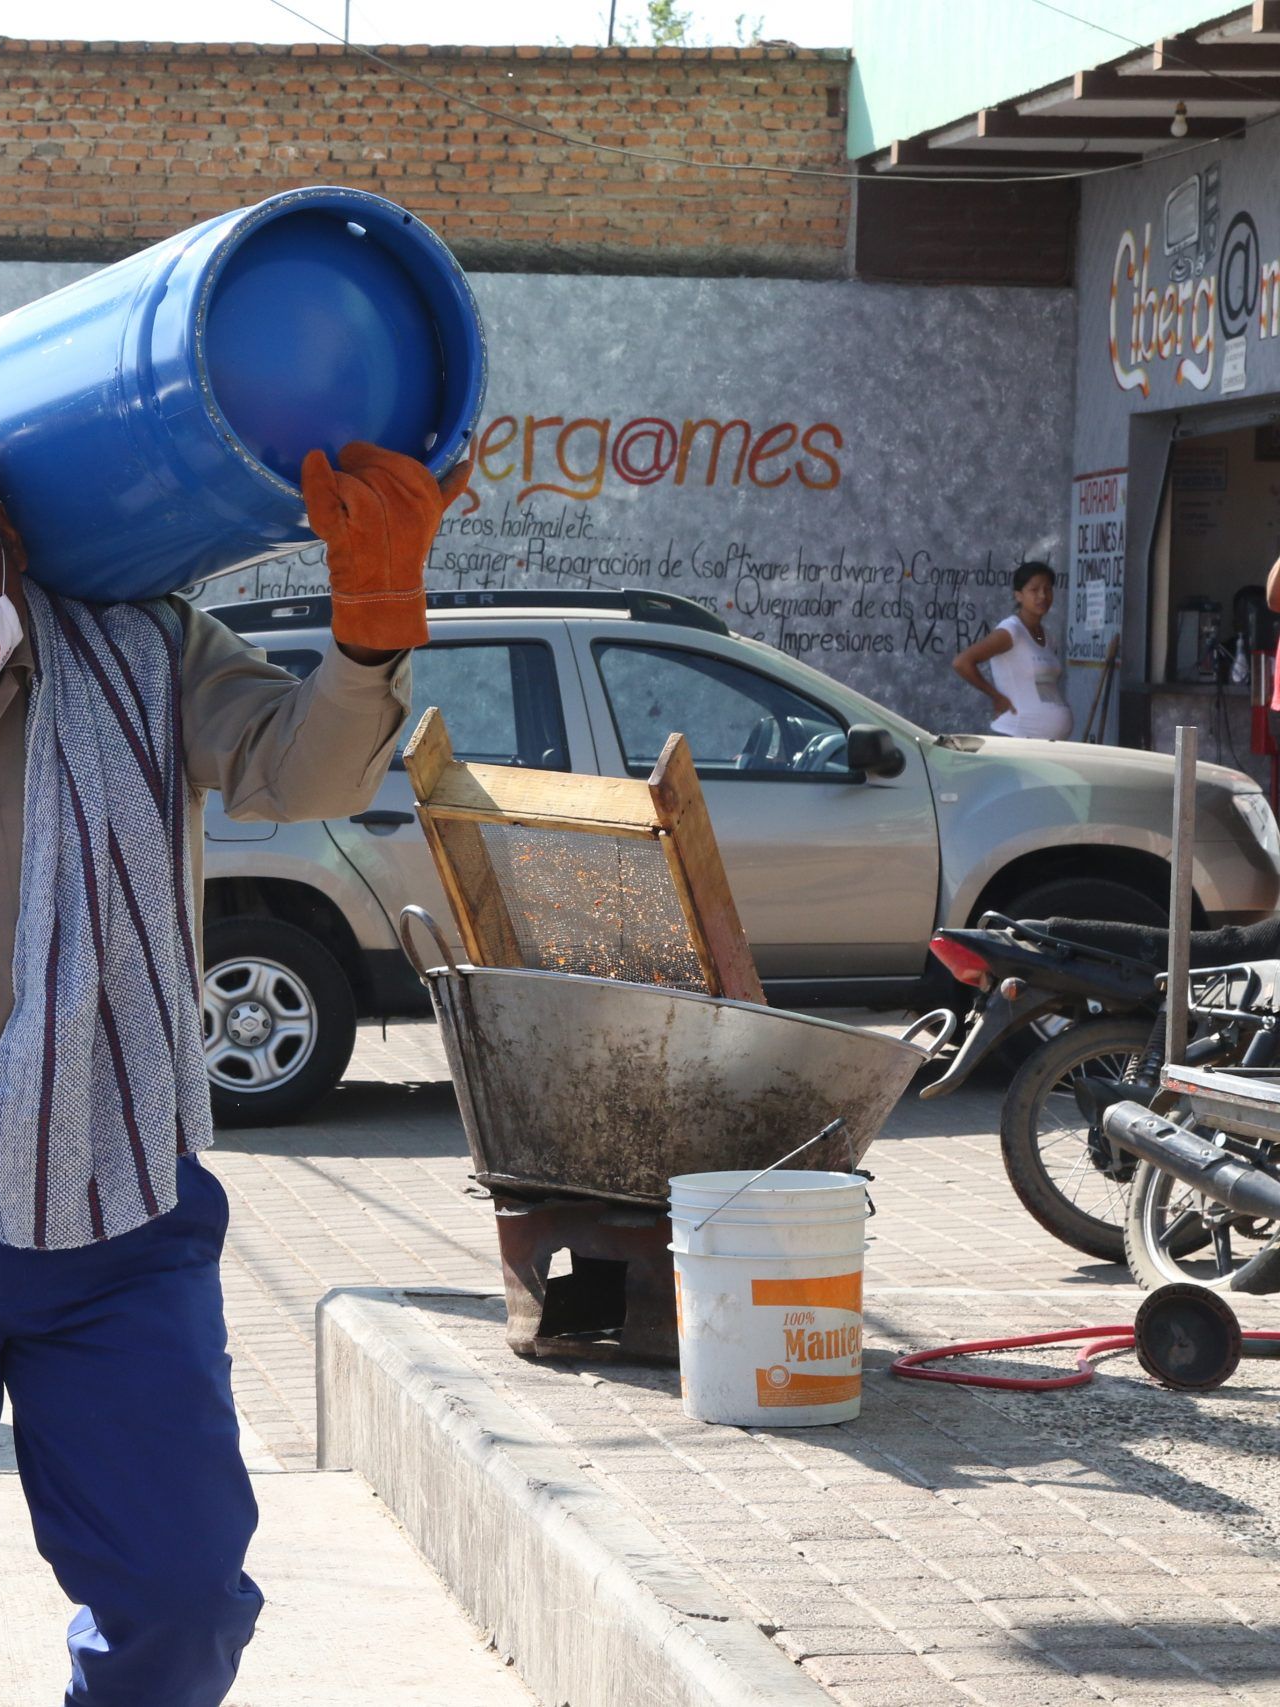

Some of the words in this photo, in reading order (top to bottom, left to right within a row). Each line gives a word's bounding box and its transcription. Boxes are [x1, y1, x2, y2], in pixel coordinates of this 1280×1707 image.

[469, 415, 843, 506] erg@mes
[1078, 477, 1118, 516] HORARIO
[1078, 523, 1089, 554] DE
[1091, 521, 1117, 553] LUNES
[427, 533, 516, 571] Escaner
[525, 537, 651, 585] Reparación
[658, 538, 683, 578] de
[1112, 555, 1124, 588] DE
[427, 593, 495, 606] TER
[734, 575, 843, 620] Quemador
[852, 582, 876, 619] de
[925, 585, 977, 622] dvd's
[771, 611, 895, 660] Impresiones
[783, 1311, 815, 1327] 100%
